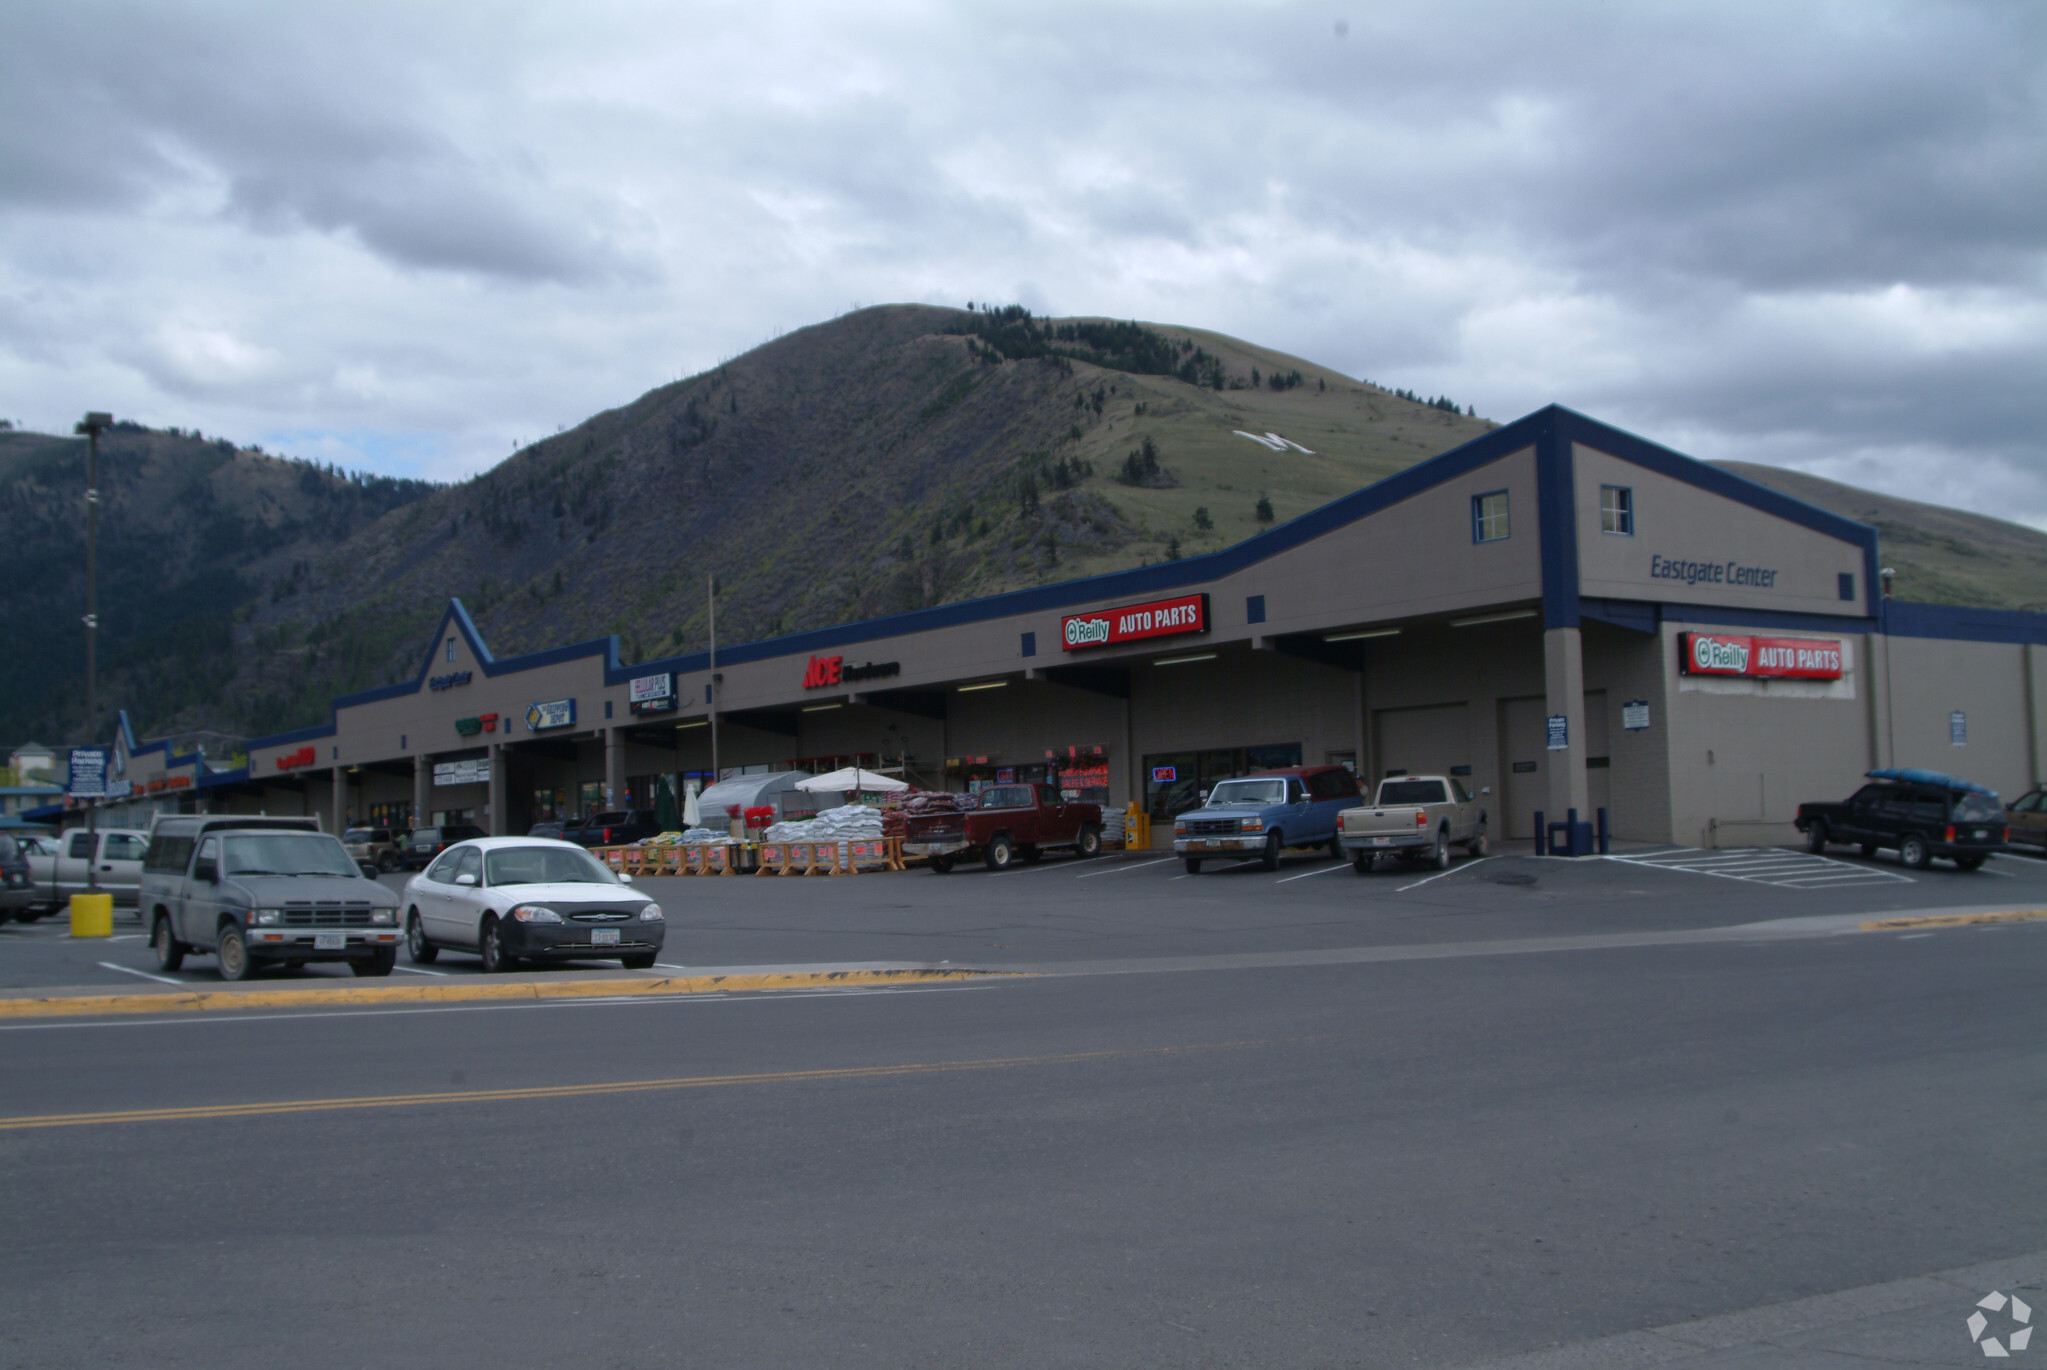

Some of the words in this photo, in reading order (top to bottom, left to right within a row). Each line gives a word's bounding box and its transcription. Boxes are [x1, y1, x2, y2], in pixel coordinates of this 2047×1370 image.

[1651, 554, 1723, 585] Eastgate
[1726, 561, 1778, 587] Center
[1066, 618, 1110, 644] O'Reilly
[1119, 612, 1151, 634] AUTO
[1155, 604, 1196, 628] PARTS
[1695, 636, 1748, 672] O'Reilly
[1759, 647, 1795, 668] AUTO
[1798, 649, 1839, 671] PARTS
[802, 654, 843, 688] ACE
[72, 750, 102, 758] Private
[1155, 768, 1175, 780] OPEN
